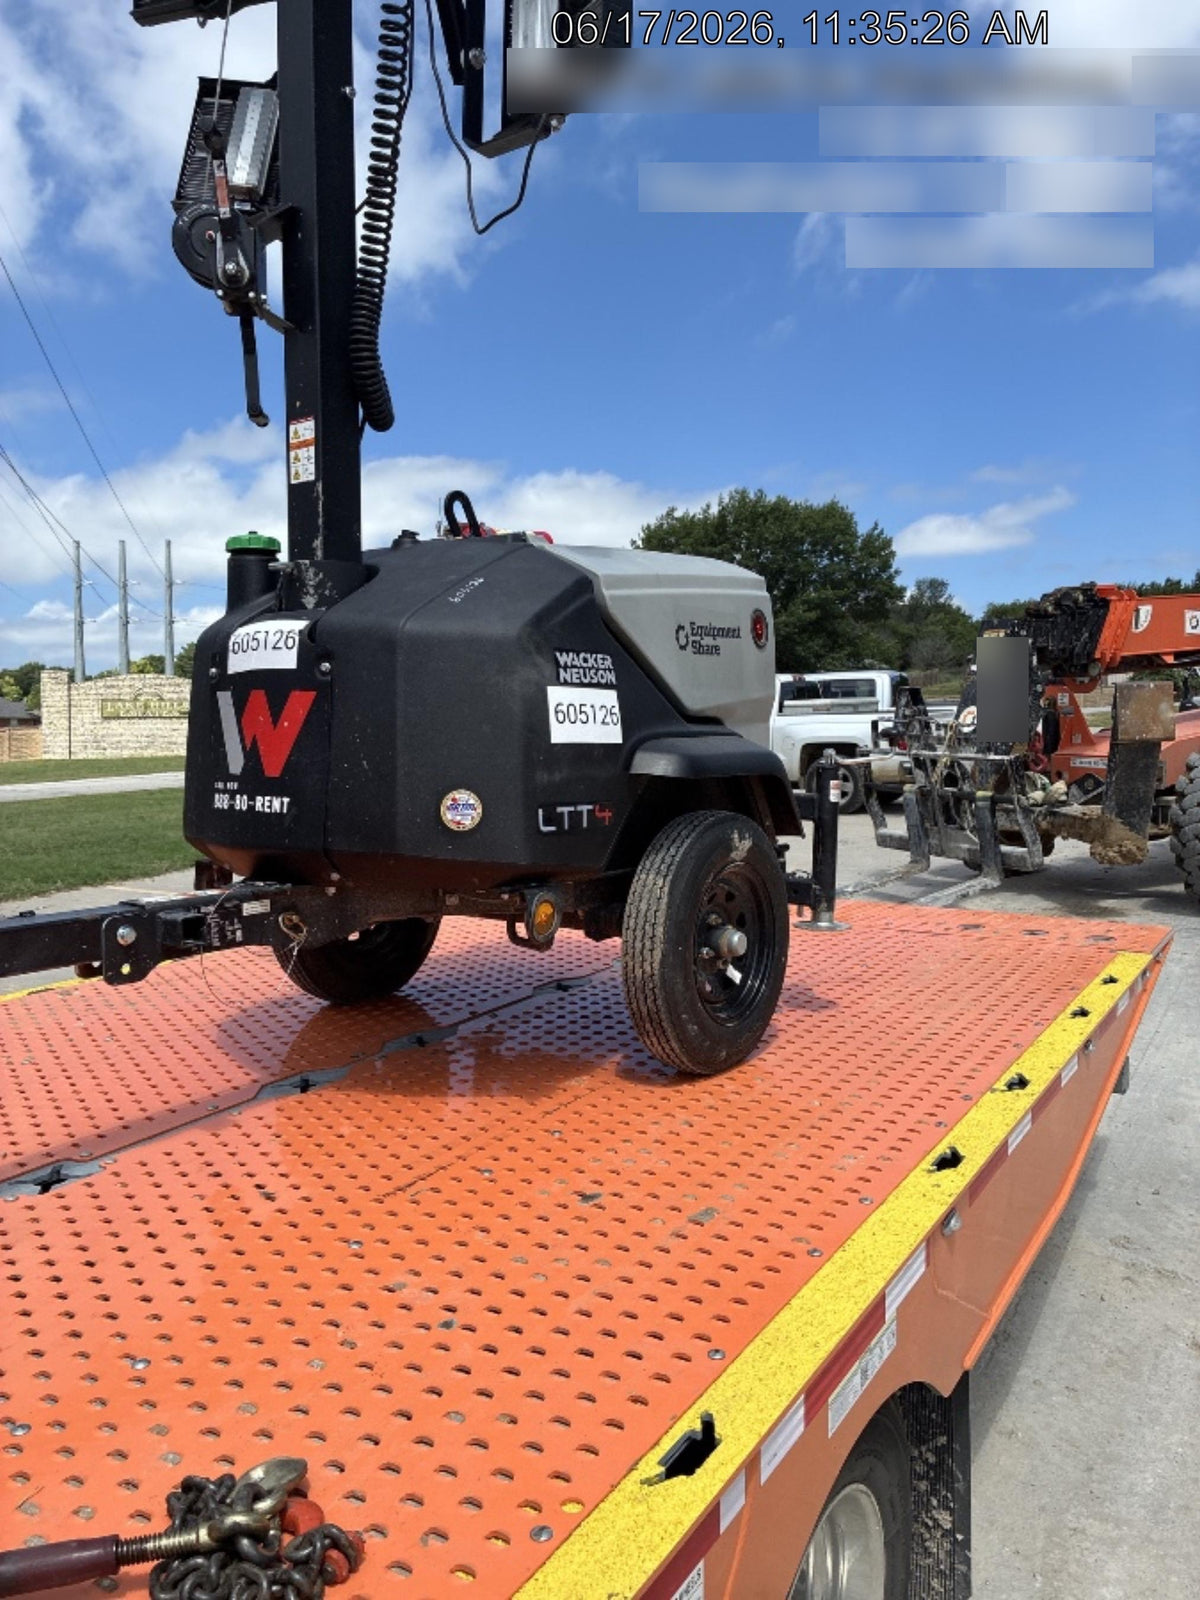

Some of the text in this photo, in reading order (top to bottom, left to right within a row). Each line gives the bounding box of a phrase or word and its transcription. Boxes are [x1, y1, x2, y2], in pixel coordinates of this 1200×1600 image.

[689, 621, 741, 641] Equipment
[231, 629, 297, 655] 605126
[691, 639, 721, 655] Share
[555, 651, 614, 669] WACKER
[559, 667, 617, 685] NEUSON
[554, 702, 620, 726] 605126
